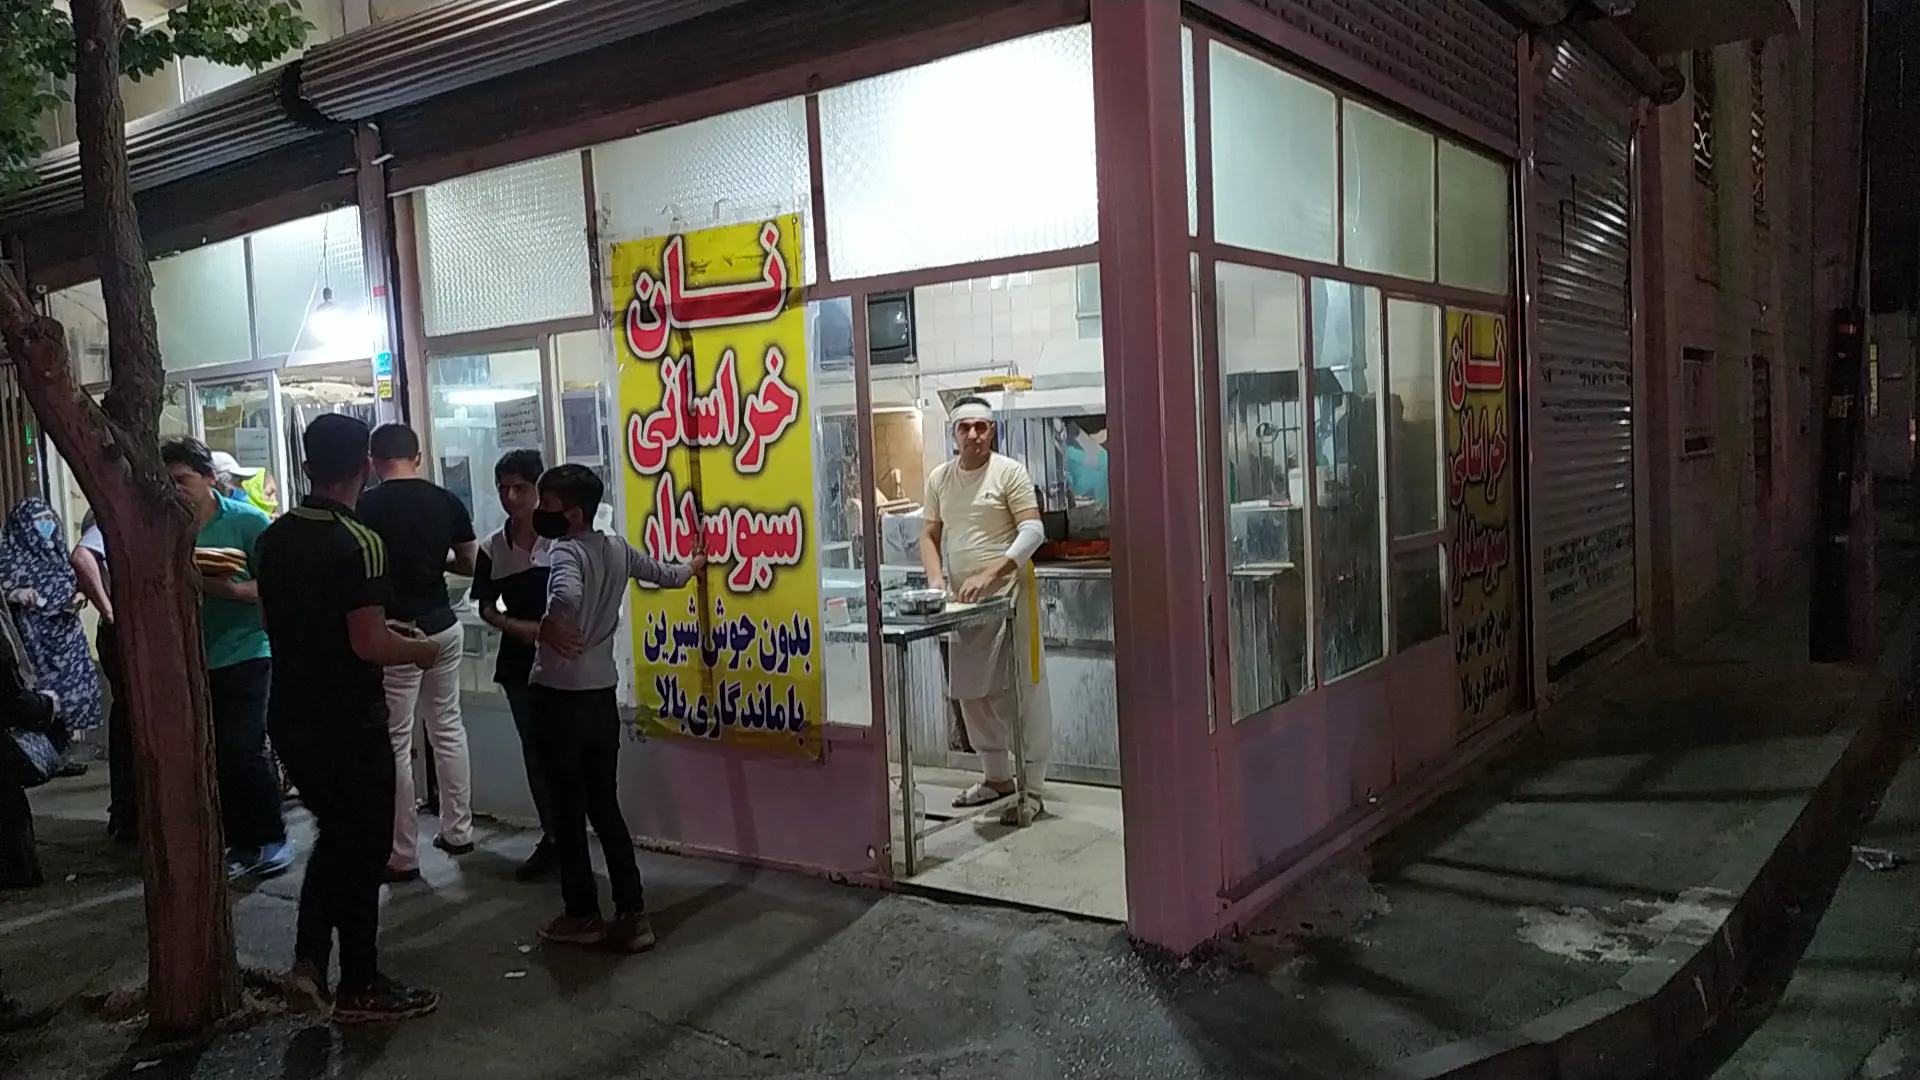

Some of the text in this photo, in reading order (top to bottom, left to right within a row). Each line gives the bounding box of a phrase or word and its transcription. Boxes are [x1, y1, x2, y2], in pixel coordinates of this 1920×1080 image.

[627, 222, 787, 360] نان
[628, 346, 799, 475] خراسانی
[1449, 313, 1505, 411] نان
[644, 596, 812, 674] بدون جوش شیرین
